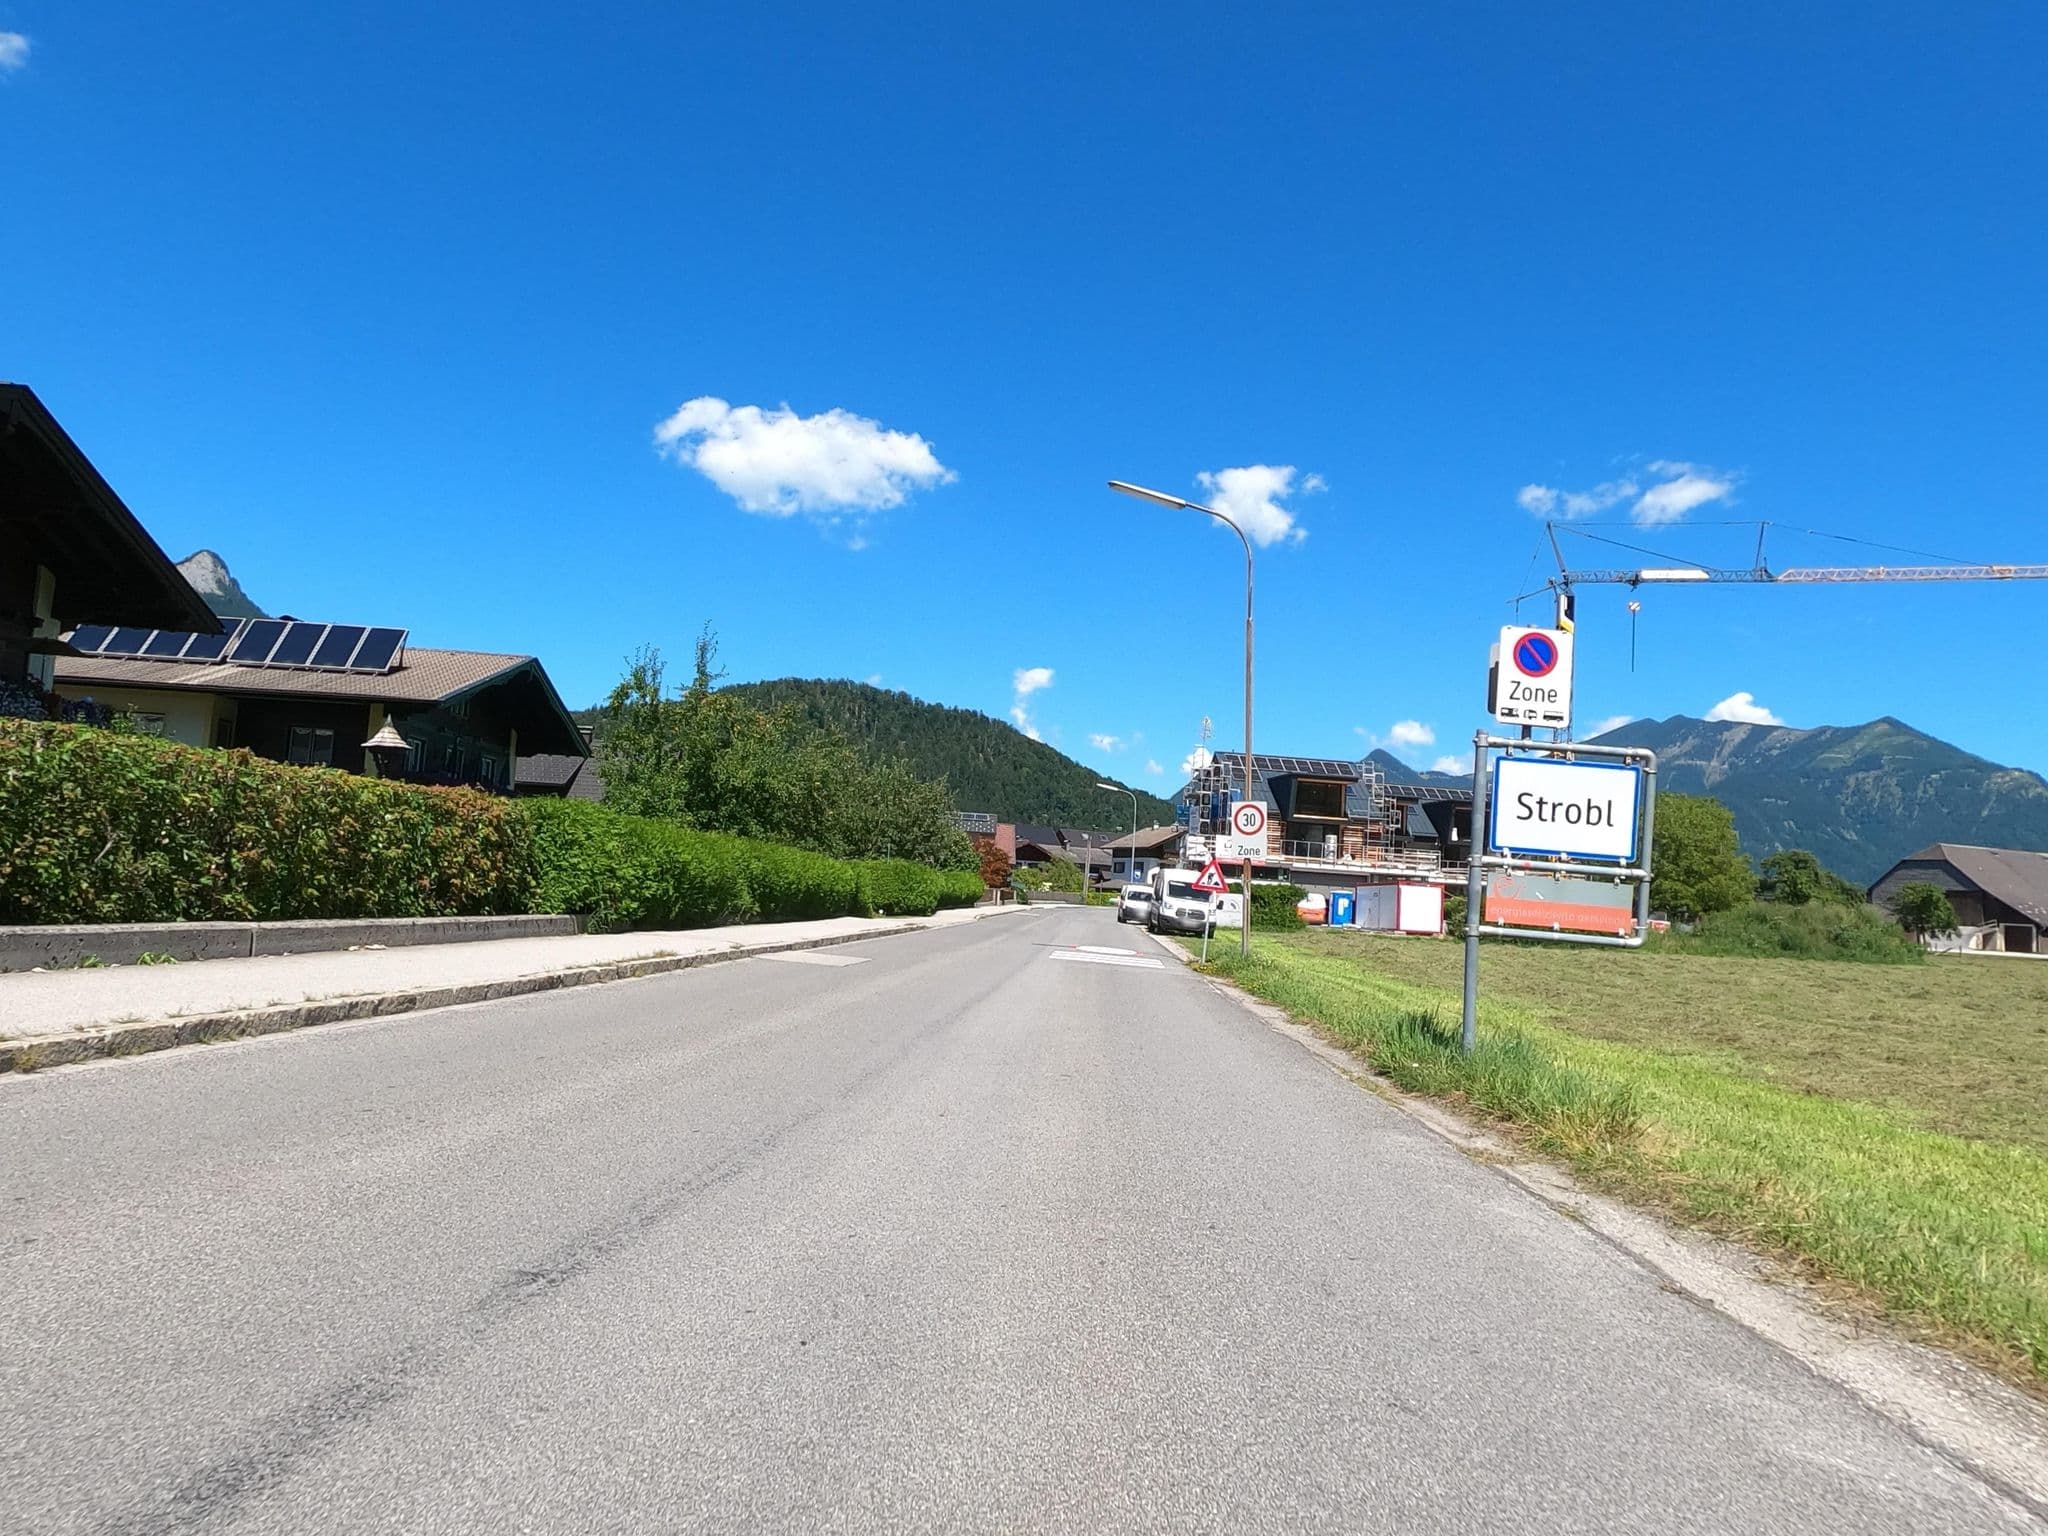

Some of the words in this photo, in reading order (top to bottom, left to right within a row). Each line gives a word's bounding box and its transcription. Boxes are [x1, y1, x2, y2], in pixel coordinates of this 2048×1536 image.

[1509, 680, 1558, 704] Zone
[1516, 792, 1614, 827] Strobl
[1242, 813, 1256, 827] 30
[1237, 845, 1261, 856] Zone
